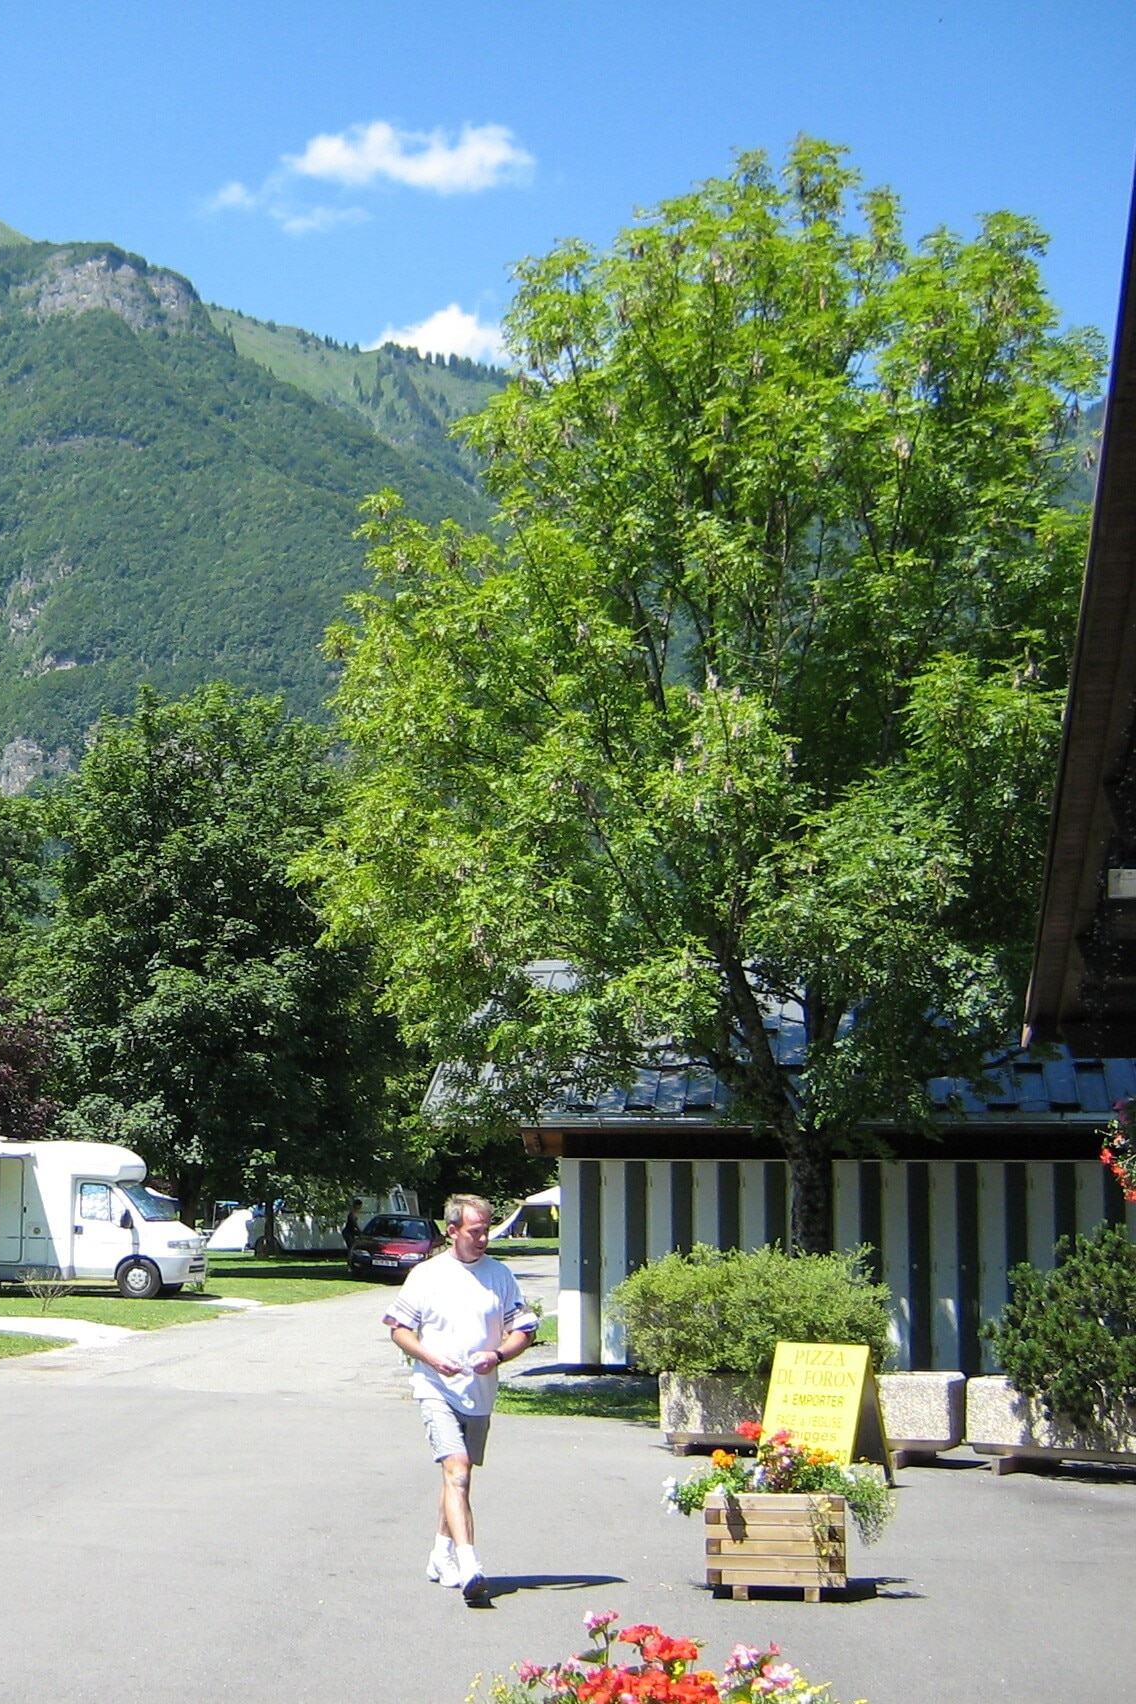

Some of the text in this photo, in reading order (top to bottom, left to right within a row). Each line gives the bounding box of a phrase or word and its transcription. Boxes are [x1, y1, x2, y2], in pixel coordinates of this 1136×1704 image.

[794, 1349, 845, 1367] PIZZA
[776, 1368, 857, 1387] DU FORON
[792, 1393, 844, 1408] EMPORTER
[776, 1414, 796, 1426] FACE
